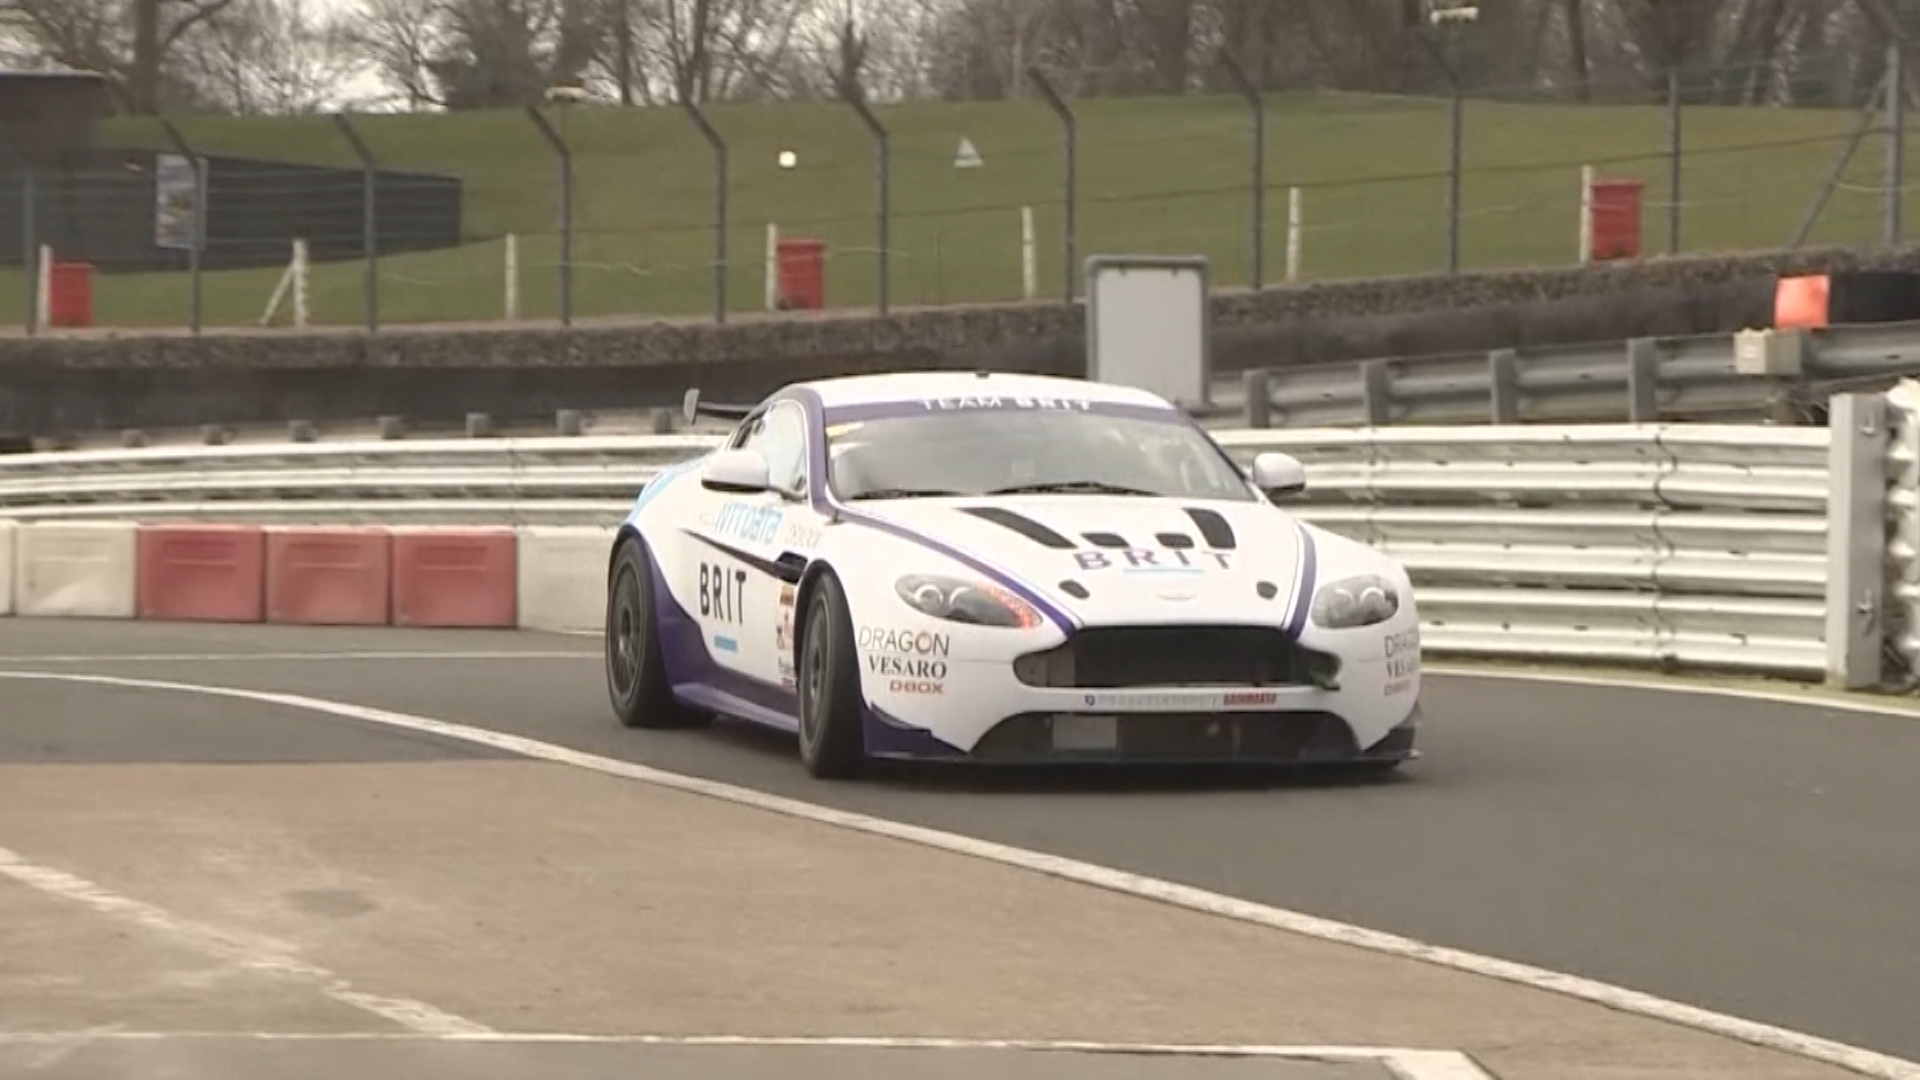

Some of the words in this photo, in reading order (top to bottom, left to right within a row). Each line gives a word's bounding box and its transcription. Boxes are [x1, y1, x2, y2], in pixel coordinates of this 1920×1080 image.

[918, 397, 1002, 410] TEAM
[1015, 397, 1091, 411] BRIT
[1073, 550, 1232, 570] BRIT
[700, 562, 747, 626] BRIT
[858, 625, 950, 658] DRAGON
[868, 654, 947, 679] VESARO
